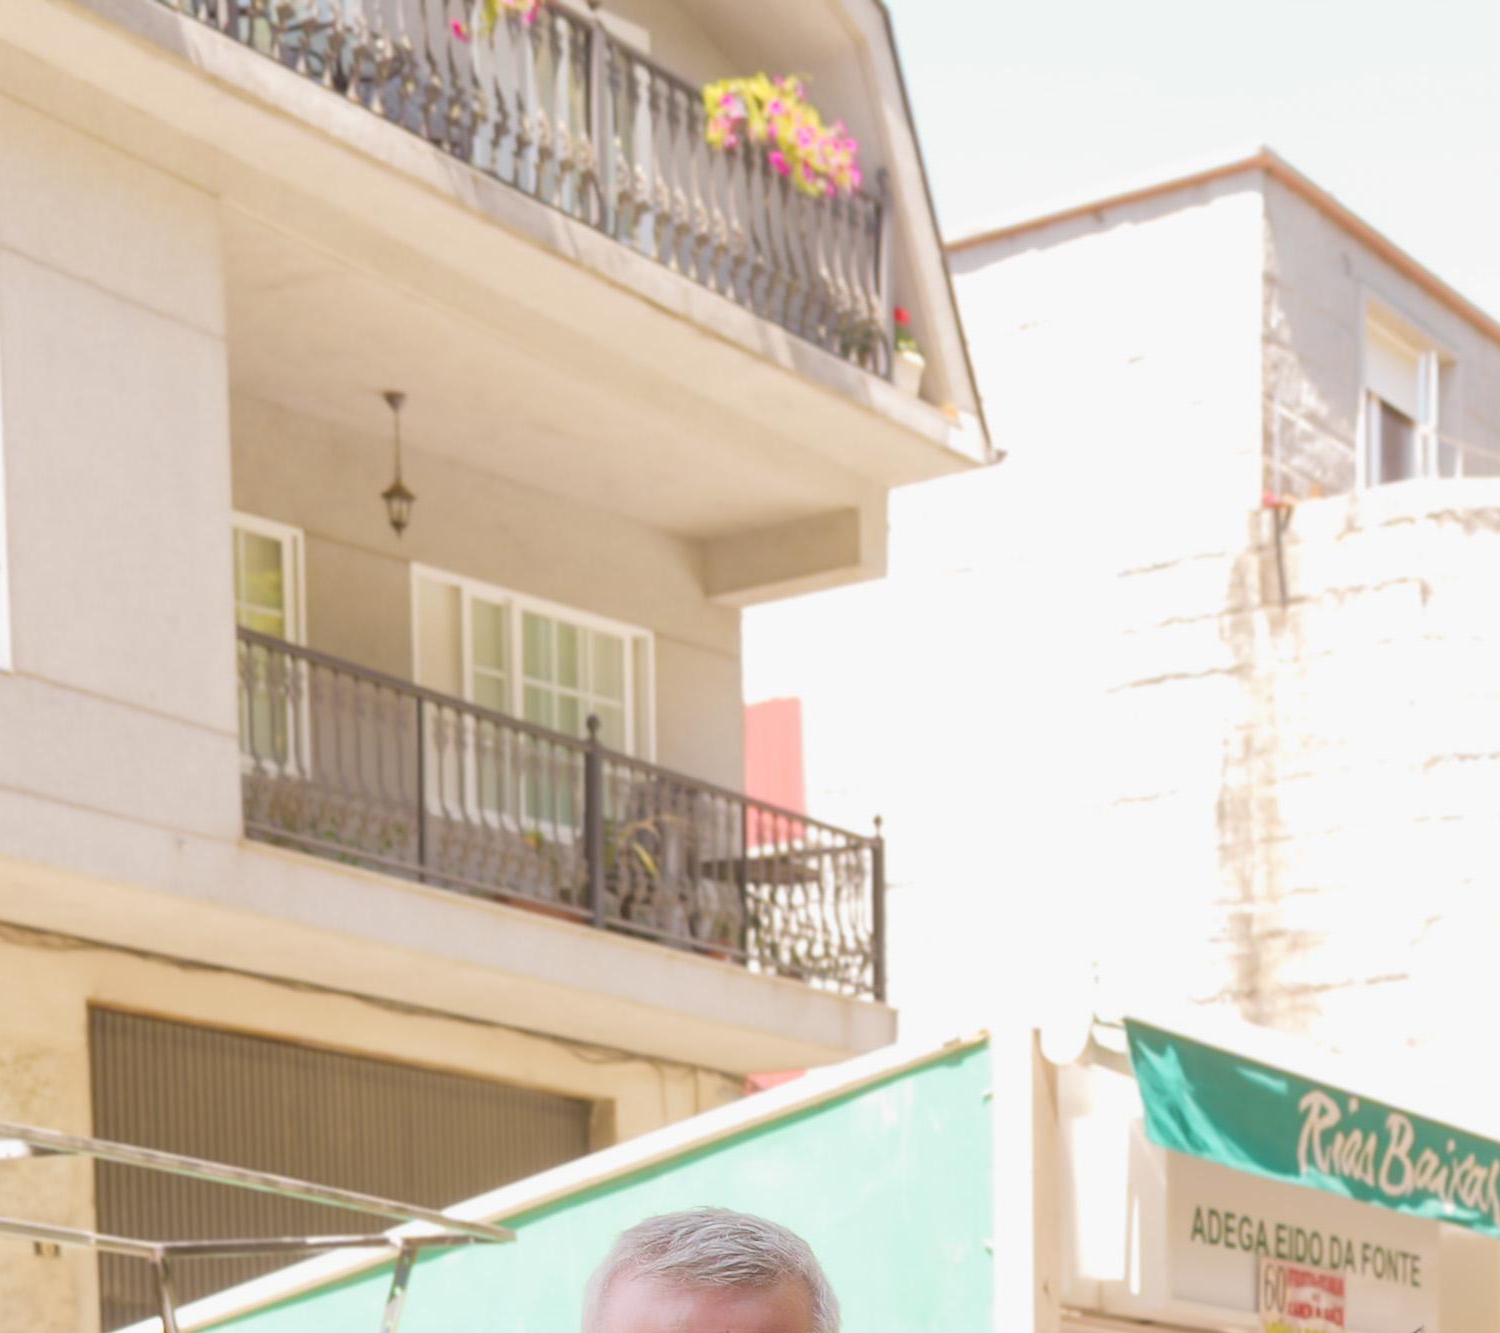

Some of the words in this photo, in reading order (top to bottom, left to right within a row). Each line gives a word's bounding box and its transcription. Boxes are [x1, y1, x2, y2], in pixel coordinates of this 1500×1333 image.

[1190, 1206, 1269, 1256] ADEGA
[1274, 1223, 1324, 1266] EIDO
[1328, 1234, 1357, 1273] DA
[1361, 1242, 1422, 1289] FONTE
